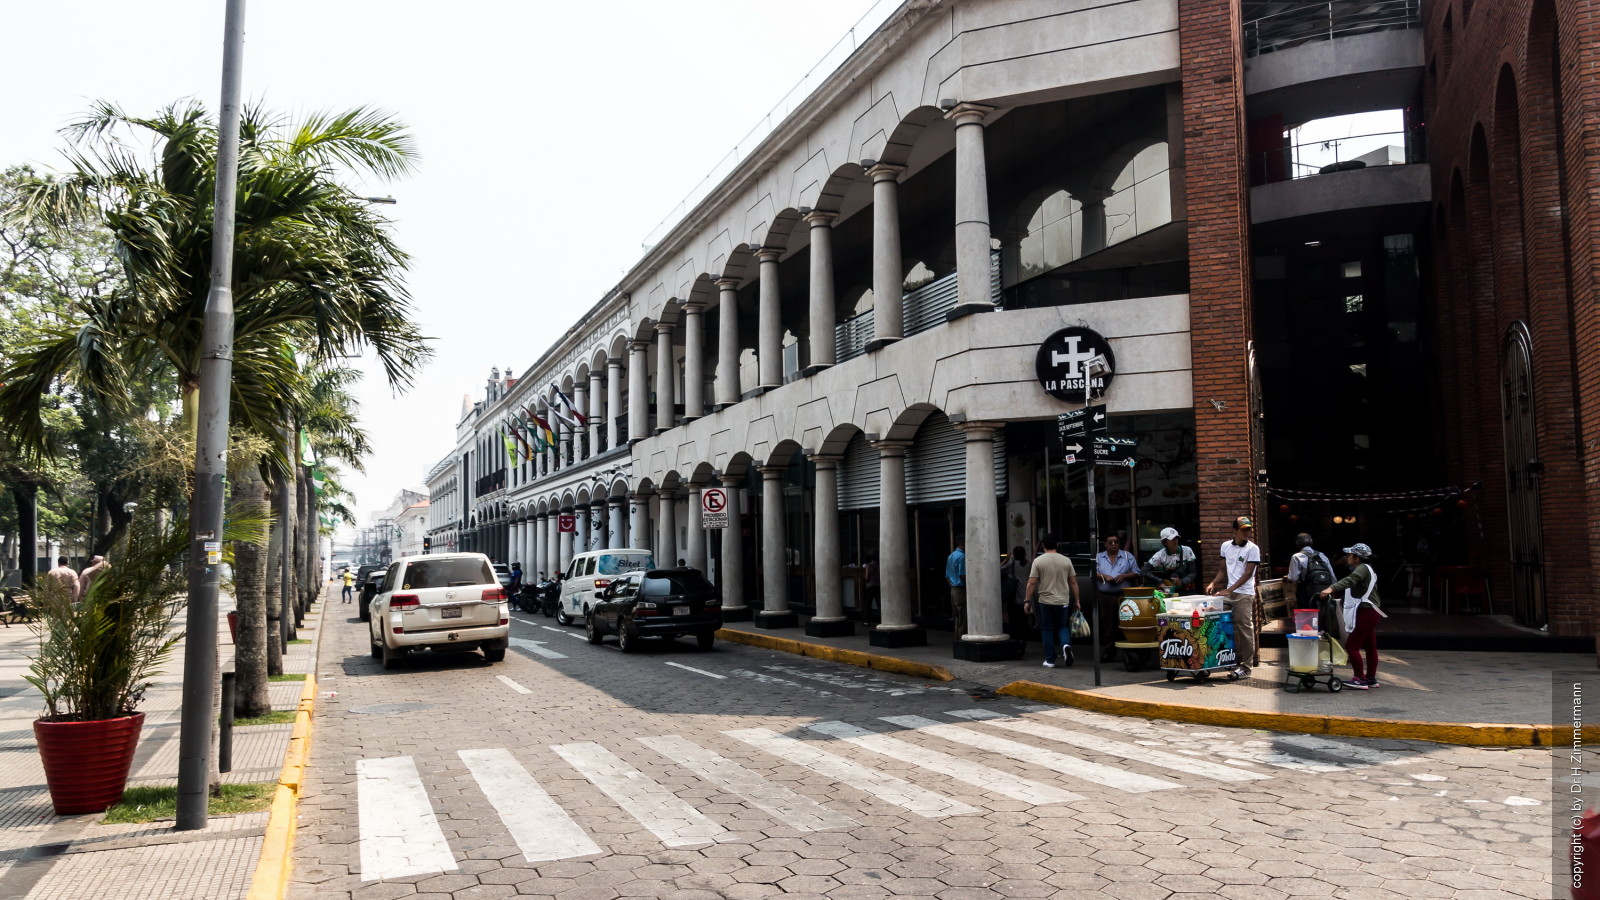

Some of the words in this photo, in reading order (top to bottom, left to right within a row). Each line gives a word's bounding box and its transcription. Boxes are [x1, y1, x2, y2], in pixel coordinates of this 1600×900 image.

[1045, 380, 1057, 391] LA
[1060, 377, 1104, 390] PASCNA
[1160, 638, 1193, 659] Tordo
[1215, 648, 1236, 666] Tordo
